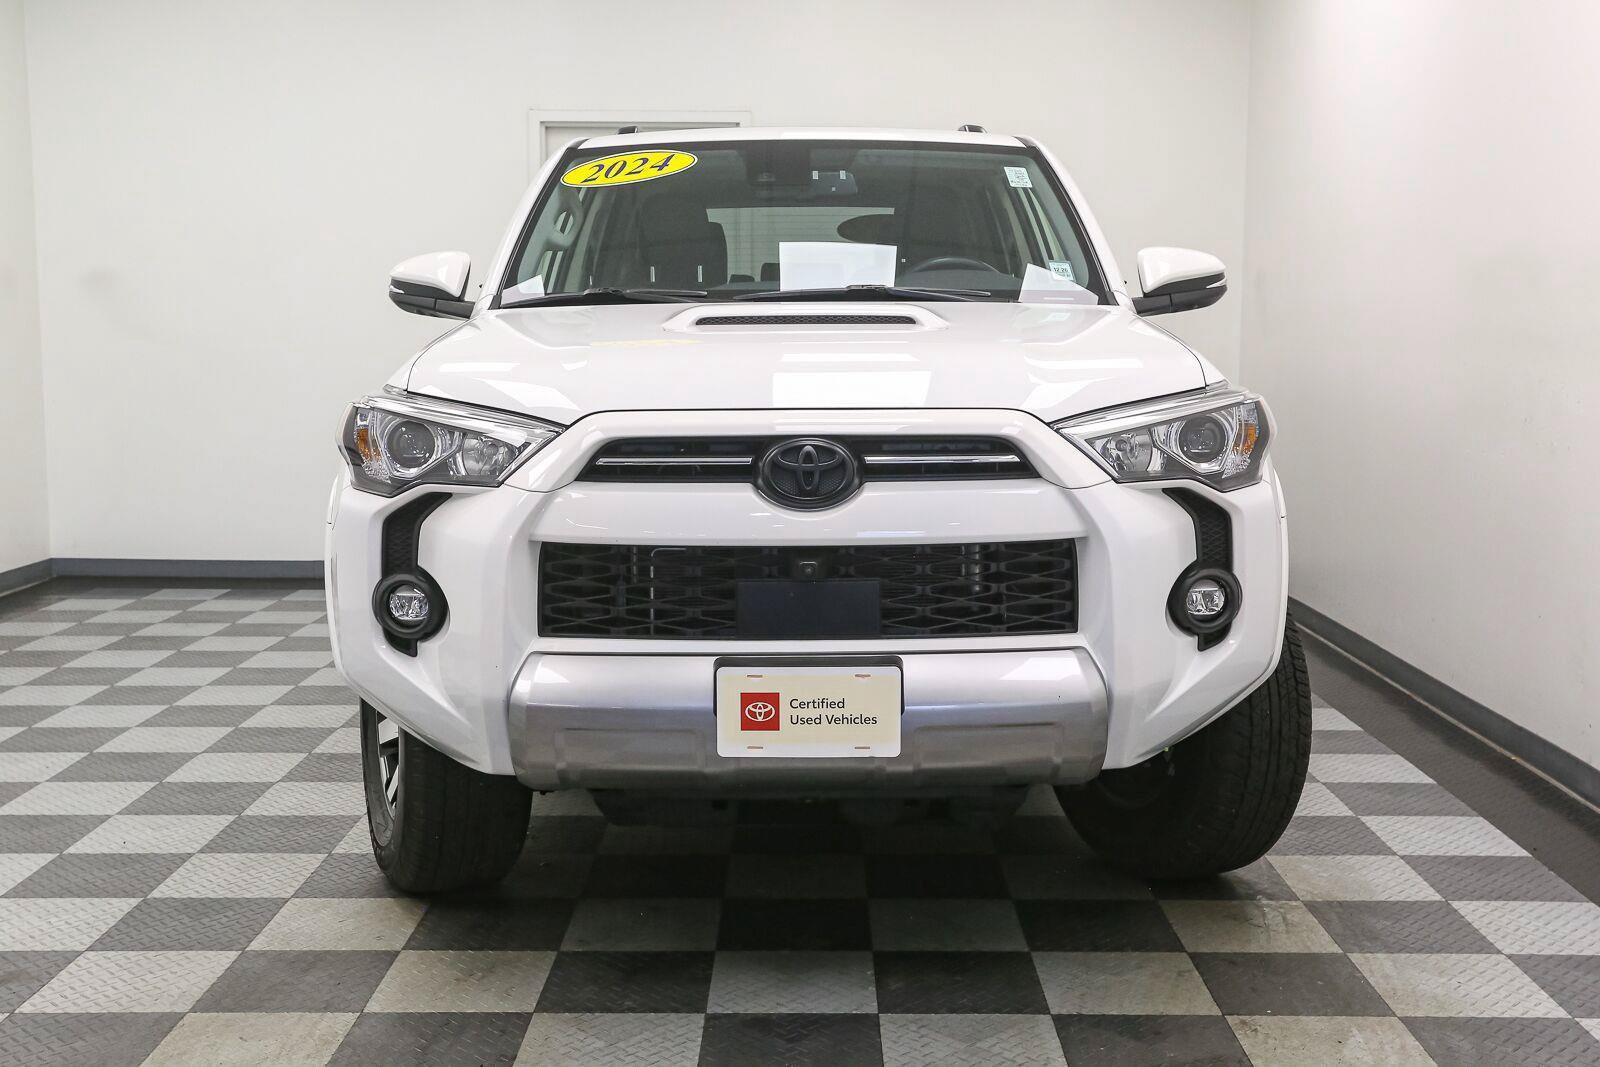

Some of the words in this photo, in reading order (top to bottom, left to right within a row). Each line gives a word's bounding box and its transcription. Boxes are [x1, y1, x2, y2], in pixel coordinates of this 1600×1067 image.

[580, 153, 676, 184] 2024
[789, 698, 845, 709] Certified
[790, 714, 822, 725] Used
[825, 714, 878, 725] Vehicles
